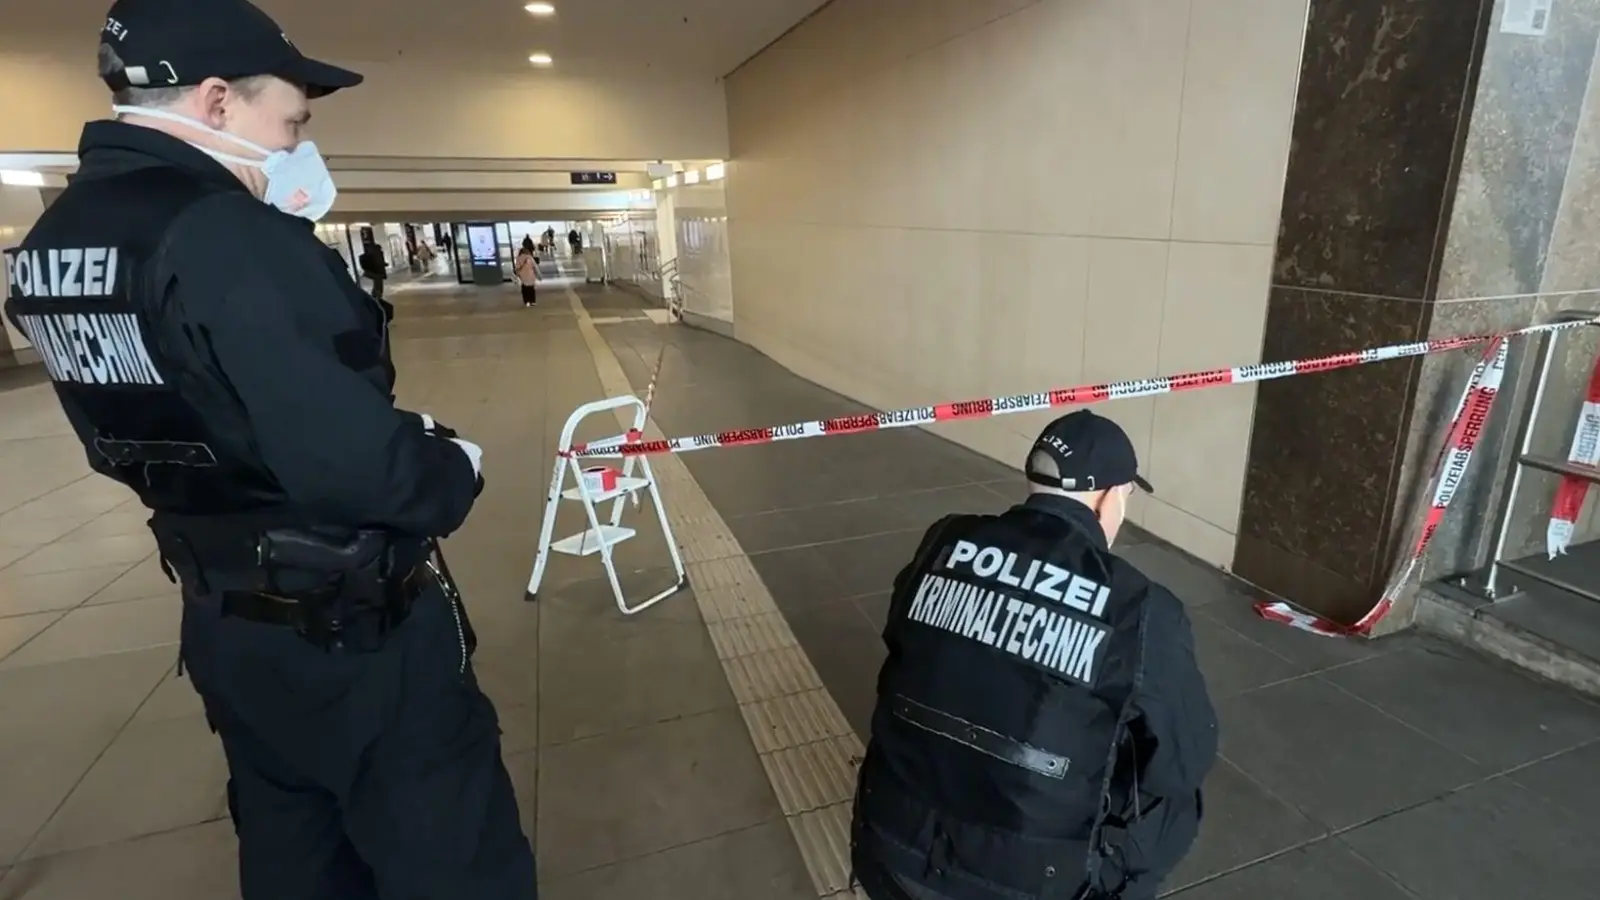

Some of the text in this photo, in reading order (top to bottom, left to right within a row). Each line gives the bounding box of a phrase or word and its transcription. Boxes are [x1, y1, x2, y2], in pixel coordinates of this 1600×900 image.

[820, 406, 936, 432] POLIZEIABSPERRUNG
[952, 389, 1075, 416] POLIZEIABSPERRUNG
[693, 424, 805, 447] POLIZEIABSPERRUNG
[1436, 386, 1496, 510] POLIZEIABSPERRUNG
[946, 540, 1111, 617] POLIZEI
[907, 573, 1106, 683] KRIMINALTECHNIK
